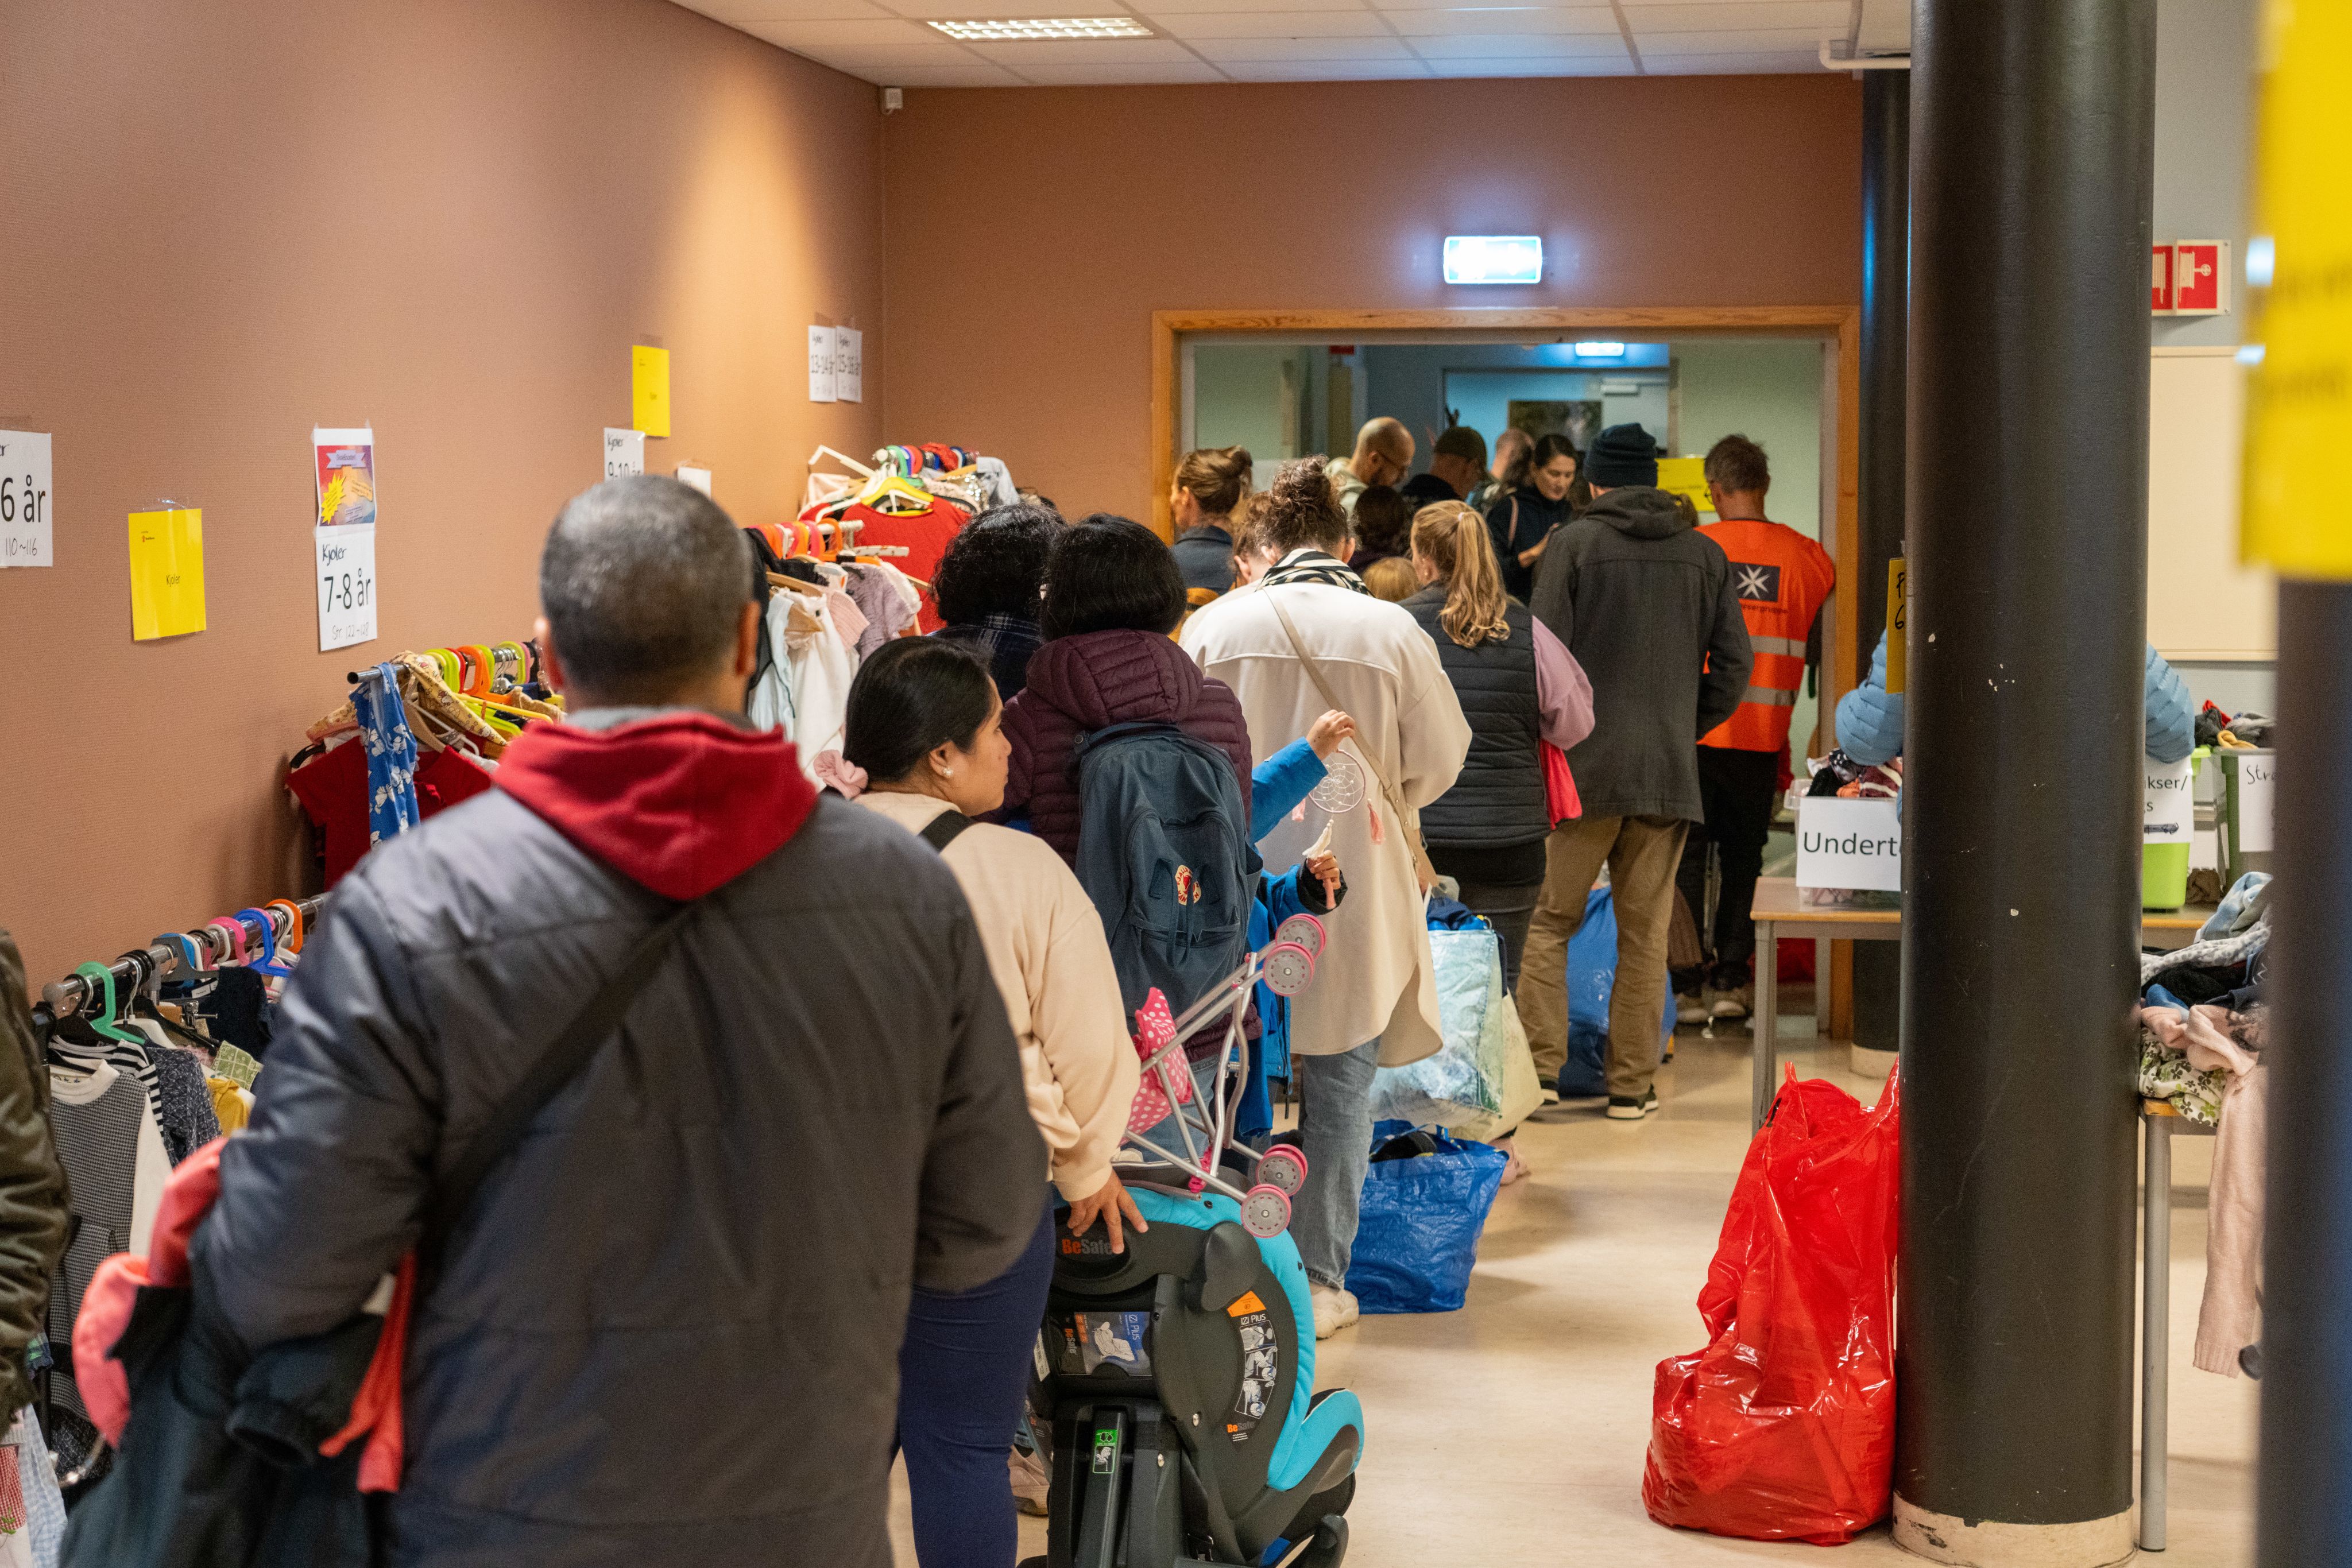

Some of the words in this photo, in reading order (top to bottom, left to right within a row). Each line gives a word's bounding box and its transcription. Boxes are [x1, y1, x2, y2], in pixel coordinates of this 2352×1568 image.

[1, 477, 15, 522] 6
[24, 474, 46, 523] år
[322, 544, 347, 567] Kjoler
[324, 573, 352, 613] 7-8
[357, 568, 371, 607] år
[2144, 775, 2188, 791] kser/
[1804, 831, 1901, 857] Undert
[1062, 1239, 1113, 1255] BeSafe
[1251, 1313, 1266, 1323] Plus
[1065, 1327, 1077, 1356] BeSafe
[1130, 1324, 1140, 1341] Plus
